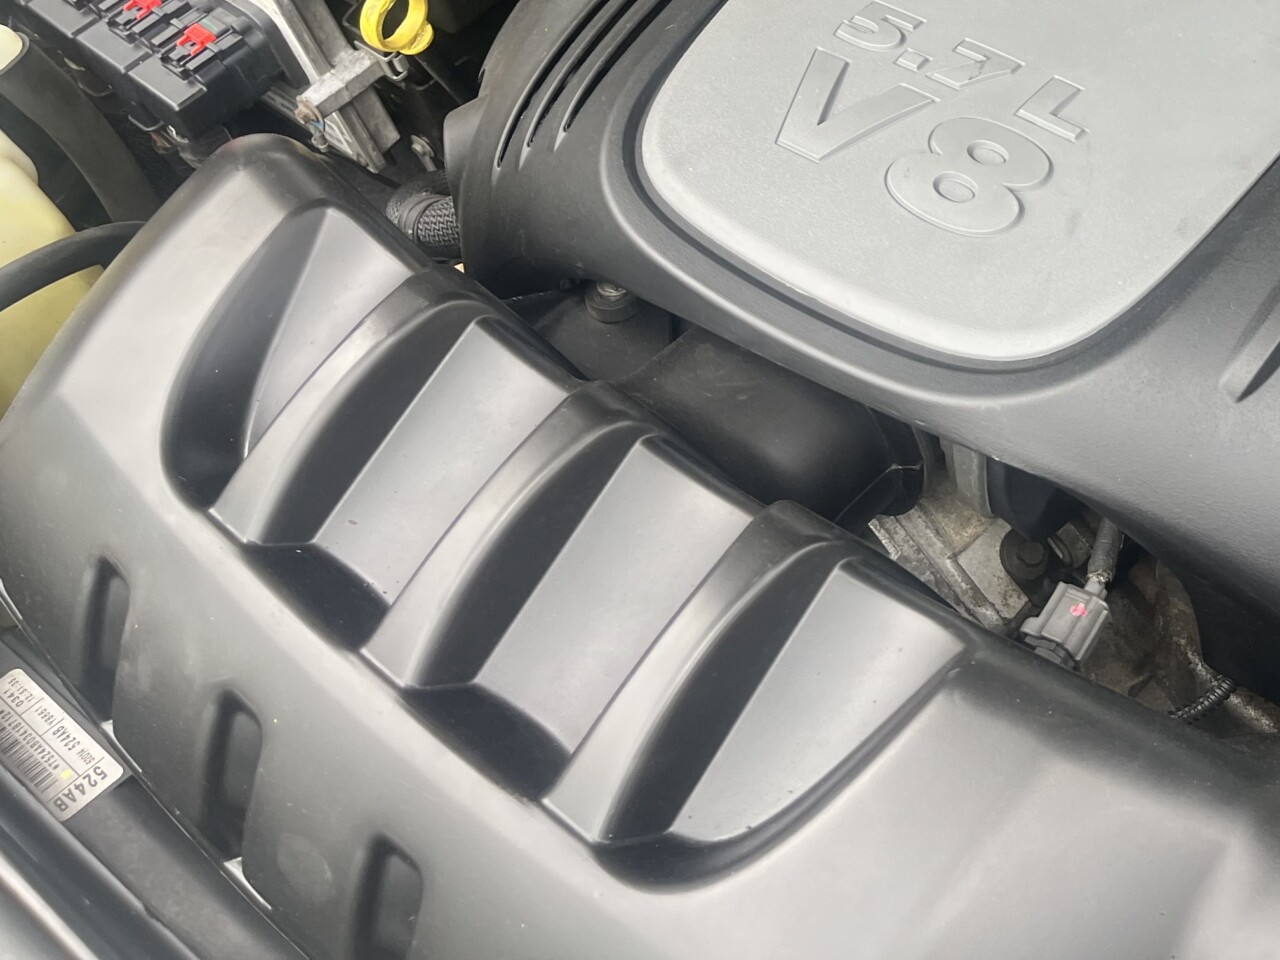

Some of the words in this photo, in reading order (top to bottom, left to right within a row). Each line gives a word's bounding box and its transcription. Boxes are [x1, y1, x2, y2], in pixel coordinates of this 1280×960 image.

[775, 46, 1055, 238] V8
[52, 725, 82, 751] 524AB
[54, 766, 108, 812] 524AB
